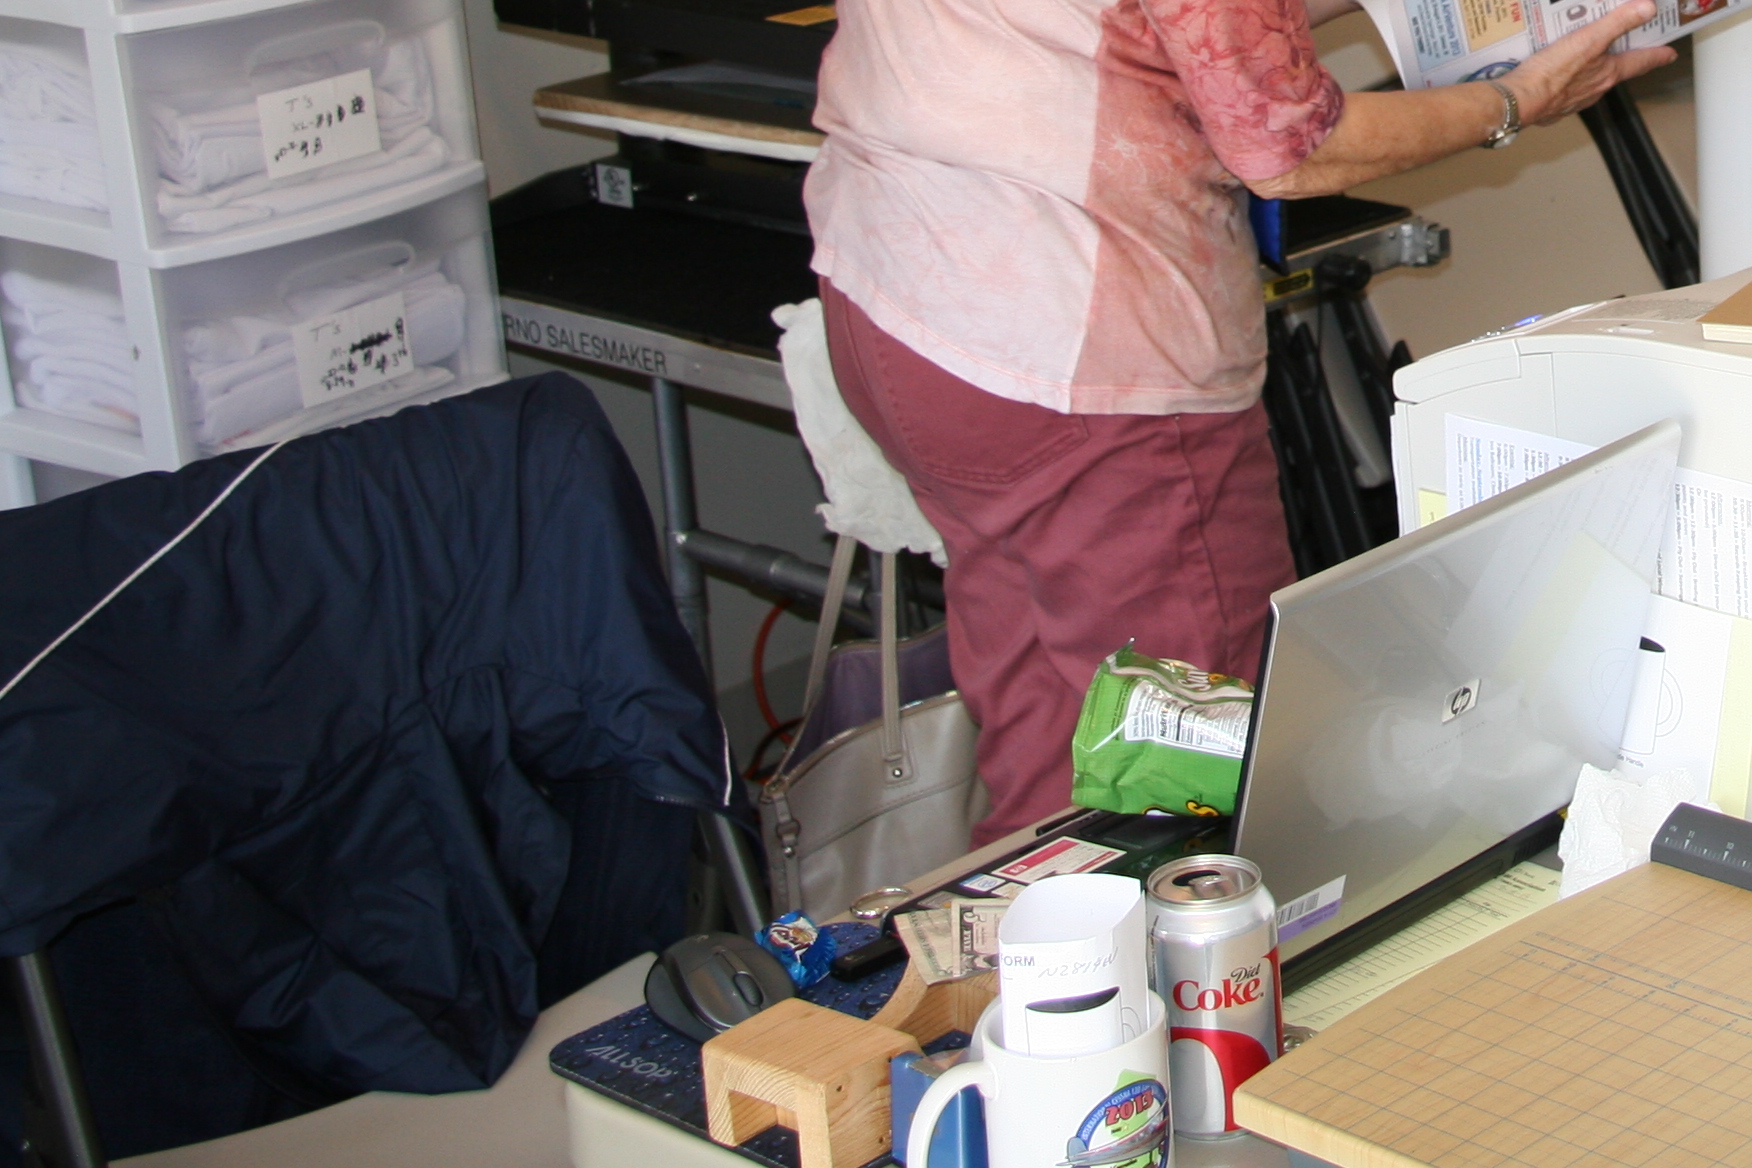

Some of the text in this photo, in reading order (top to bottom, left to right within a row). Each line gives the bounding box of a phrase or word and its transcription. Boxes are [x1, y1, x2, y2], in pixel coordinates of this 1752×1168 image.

[1510, 2, 1521, 23] FUN
[547, 324, 668, 374] SALESMAKER
[1687, 830, 1696, 838] 11
[1726, 841, 1735, 850] 10
[1231, 963, 1261, 983] Diet
[1173, 978, 1262, 1011] Coke
[585, 1045, 672, 1079] ALLSOP
[1105, 1087, 1154, 1128] 2013
